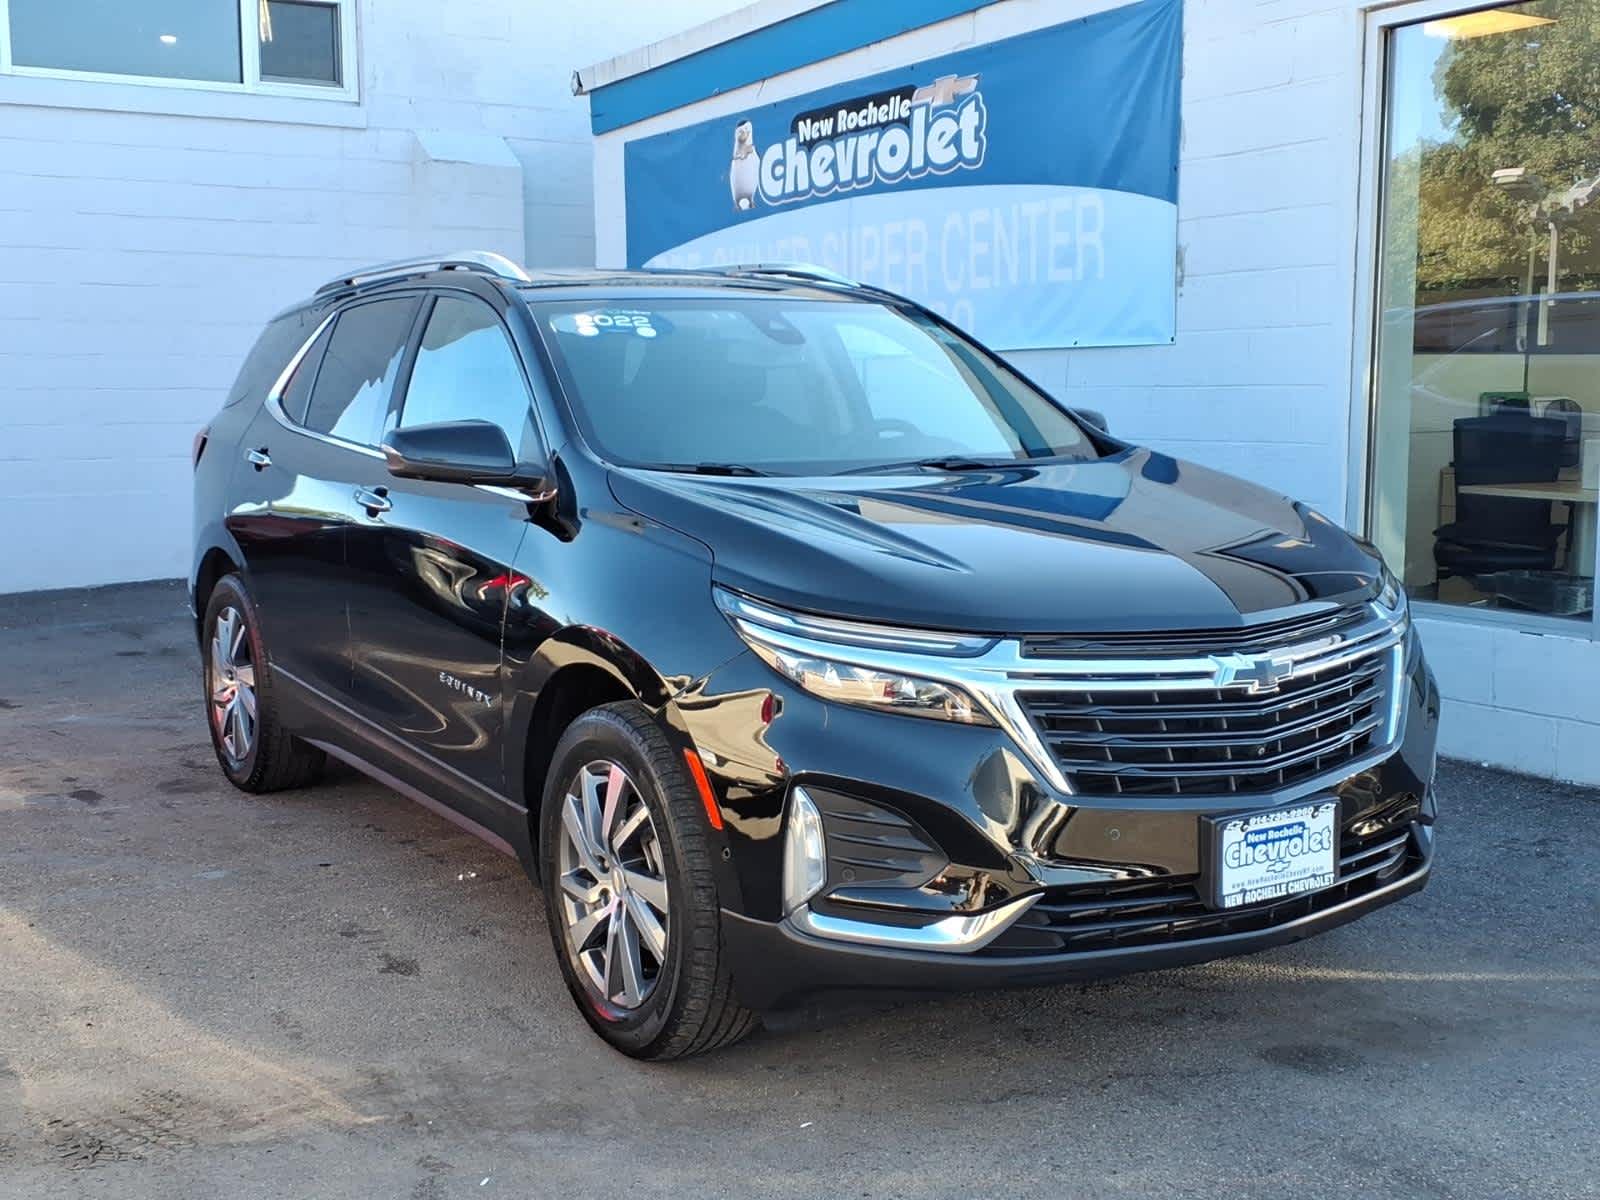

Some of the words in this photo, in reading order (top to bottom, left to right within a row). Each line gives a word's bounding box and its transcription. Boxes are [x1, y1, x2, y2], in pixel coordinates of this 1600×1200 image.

[797, 117, 834, 144] New
[836, 97, 912, 133] Rochelle
[759, 98, 984, 201] Chevrolet
[941, 193, 1106, 294] CENTER
[1225, 826, 1331, 869] Chevrolet
[1247, 832, 1267, 844] New
[1268, 825, 1305, 840] Rochelle
[1224, 891, 1244, 908] NEW
[1245, 883, 1287, 904] ROCHELLE
[1288, 874, 1335, 895] CHEVROLET
